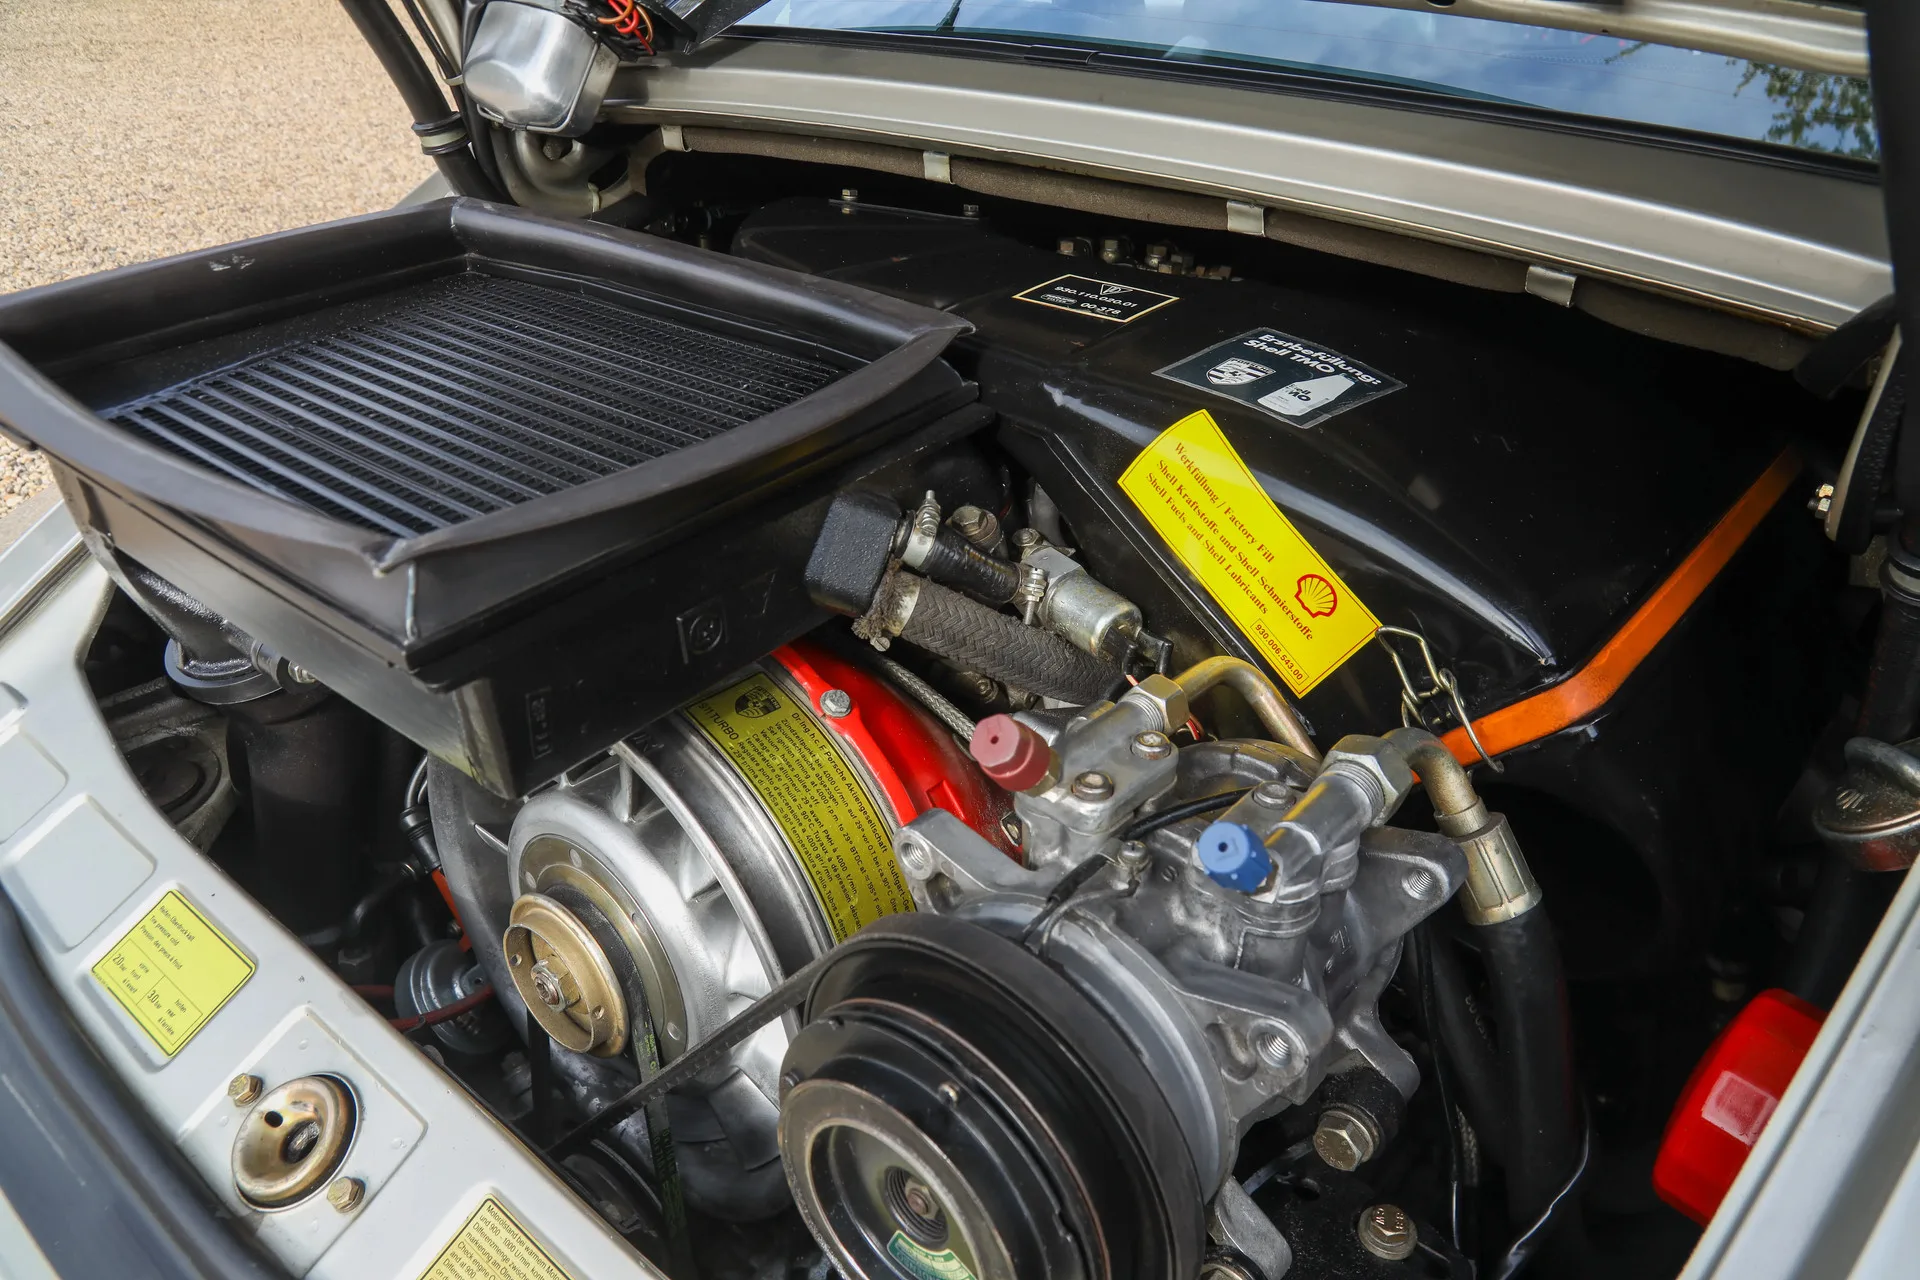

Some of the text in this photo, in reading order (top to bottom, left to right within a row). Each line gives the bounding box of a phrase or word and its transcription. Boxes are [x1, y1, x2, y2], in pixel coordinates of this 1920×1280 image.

[1243, 339, 1335, 374] Shell TMO
[1258, 334, 1382, 385] Erstbefüllung:
[1175, 442, 1219, 504] Werkfüllung
[1224, 507, 1257, 544] Factory
[1257, 544, 1275, 563] Fill
[1146, 473, 1268, 614] Shell Fuels and Shell Lubricants
[1157, 460, 1313, 641] Shell Kraftstoffe und Shell Schmierstoffe
[1255, 624, 1304, 680] 930.006.543.00
[710, 712, 740, 740] TURBO
[758, 766, 774, 786] punto
[823, 770, 836, 786] 4000
[766, 726, 778, 736] Set
[816, 788, 829, 804] 4000
[838, 823, 844, 832] to
[850, 846, 863, 866] BTDC
[860, 866, 867, 875] at
[824, 751, 847, 782] Porsche
[845, 783, 889, 855] Aktiengesellschaft
[810, 810, 824, 829] avant
[822, 829, 835, 846] PMH
[774, 774, 783, 782] de
[813, 830, 829, 855] Tuyaux
[850, 904, 862, 930] débran
[155, 923, 171, 938] pressure
[170, 937, 180, 946] cold
[838, 918, 849, 938] depre
[466, 1232, 493, 1263] markierung
[491, 1259, 502, 1270] am
[472, 1222, 510, 1264] Differenzmenge
[480, 1214, 491, 1226] und
[490, 1223, 501, 1236] 900
[502, 1238, 516, 1252] 1000
[450, 1251, 462, 1263] and
[465, 1266, 476, 1279] 900
[457, 1241, 490, 1277] Check engine
[516, 1235, 526, 1248] bei
[524, 1245, 546, 1270] warmem
